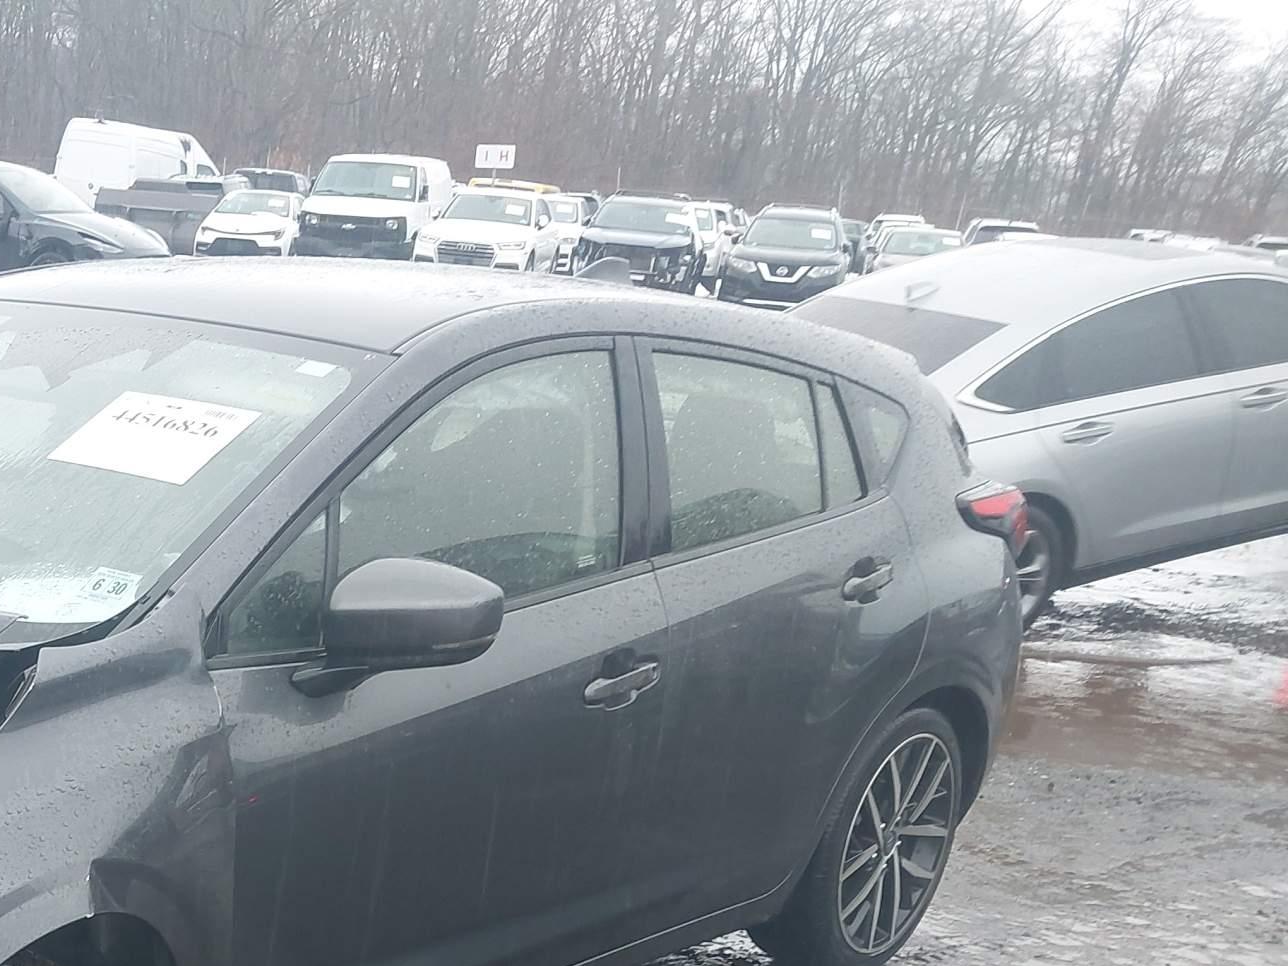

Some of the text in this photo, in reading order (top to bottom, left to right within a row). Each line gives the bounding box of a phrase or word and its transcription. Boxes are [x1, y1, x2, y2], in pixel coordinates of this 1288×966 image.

[498, 150, 509, 162] H
[111, 409, 219, 438] 44516826
[92, 578, 129, 596] 6 30
